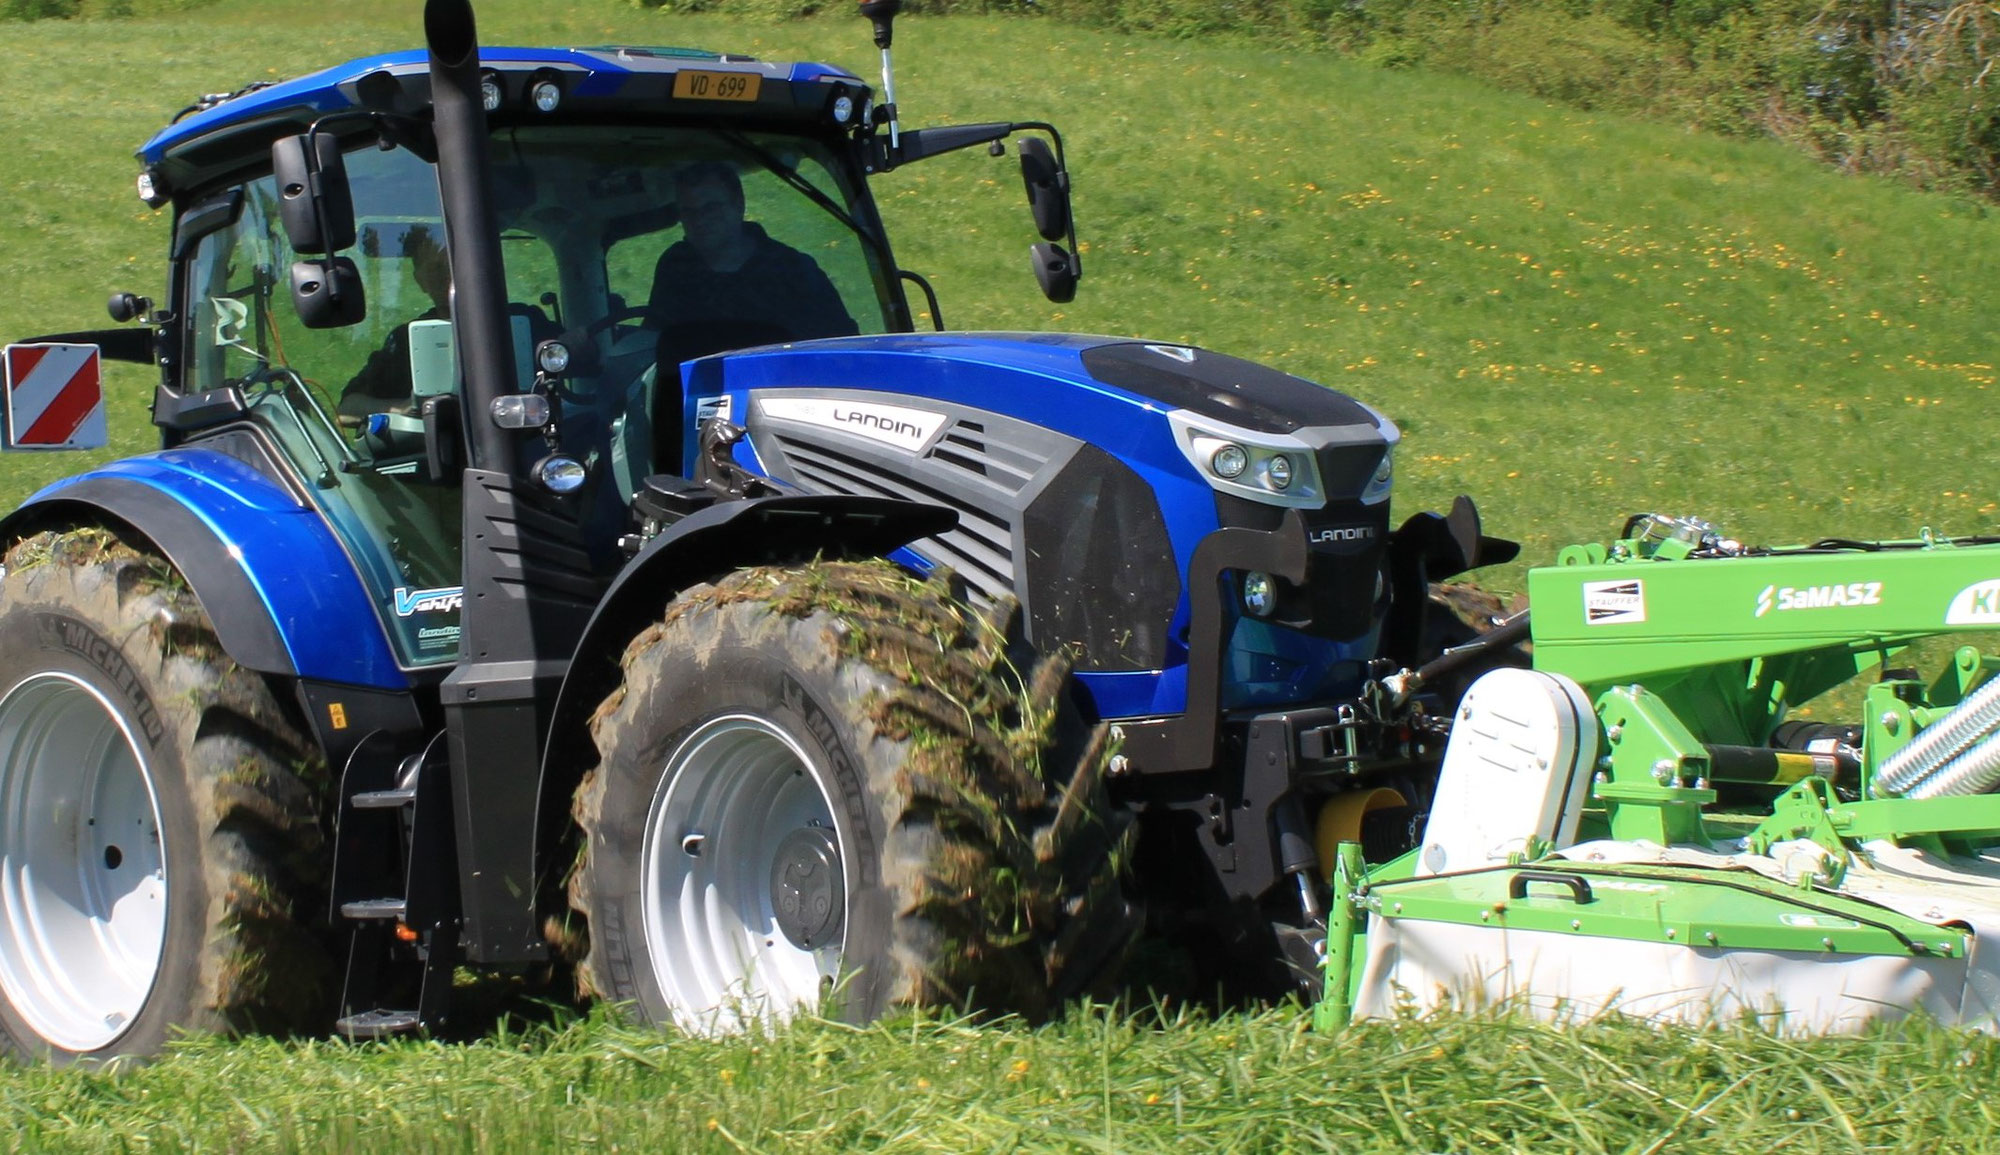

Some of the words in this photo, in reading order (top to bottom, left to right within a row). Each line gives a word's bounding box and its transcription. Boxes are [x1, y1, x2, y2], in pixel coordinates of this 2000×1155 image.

[717, 76, 746, 98] 699
[833, 408, 922, 438] LANDINI
[1309, 527, 1375, 543] LANDINI
[1776, 582, 1883, 610] SaMASZ
[64, 620, 164, 747] MICHELIN
